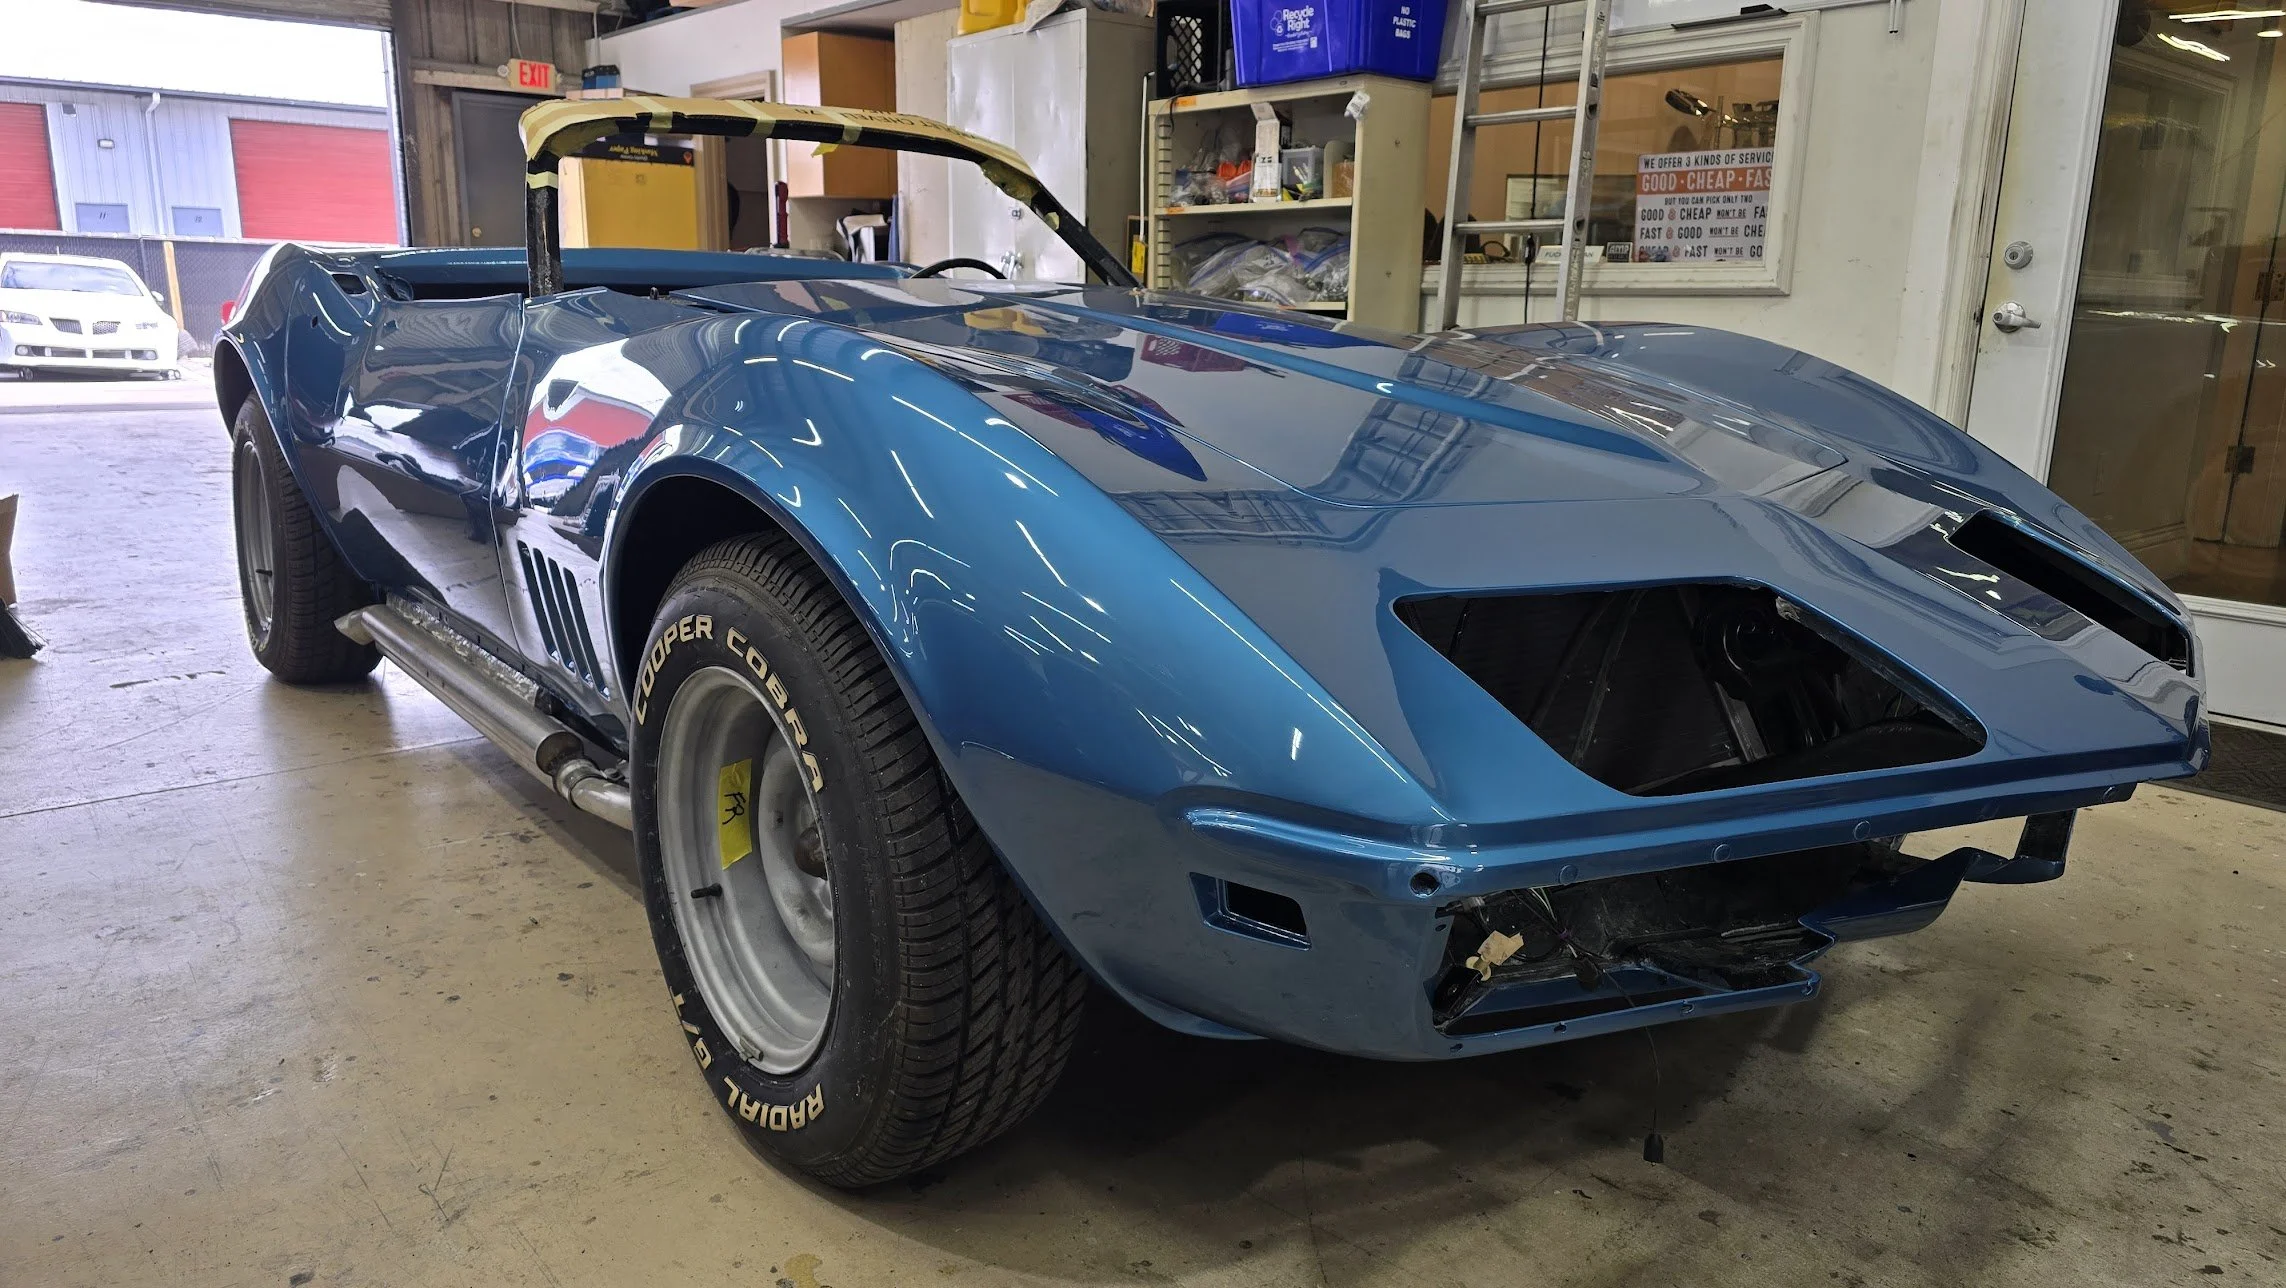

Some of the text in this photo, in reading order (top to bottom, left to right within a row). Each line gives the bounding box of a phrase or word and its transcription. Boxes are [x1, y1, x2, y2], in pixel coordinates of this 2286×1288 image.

[1283, 5, 1315, 22] Recycle
[1401, 6, 1410, 15] NO
[1287, 18, 1310, 32] Right
[1393, 16, 1416, 28] PLASTIC
[1395, 28, 1411, 39] BAGS
[520, 62, 549, 88] EXIT
[1644, 158, 1655, 169] WE
[1658, 157, 1682, 168] OFFER
[1686, 156, 1691, 167] 3
[1694, 155, 1721, 166] KINDS
[1725, 154, 1735, 165] OF
[1641, 168, 1772, 192] GOOD CHEAP FAS
[1665, 194, 1753, 205] BUT YOU CAN PICK ONLY TWO
[1641, 209, 1664, 221] GOOD
[1668, 208, 1676, 220] &
[1680, 207, 1712, 220] CHEAP
[1717, 209, 1735, 217] WON'T
[1754, 206, 1767, 219] FA
[1640, 224, 1765, 239] FAST & GOOD WON'T BE CHE
[1685, 245, 1708, 257] FAST
[1714, 247, 1732, 255] WON'T
[1736, 247, 1743, 255] BE
[1750, 245, 1762, 257] GO
[635, 614, 824, 793] COOPER COBRA
[724, 1083, 825, 1132] RADIAL
